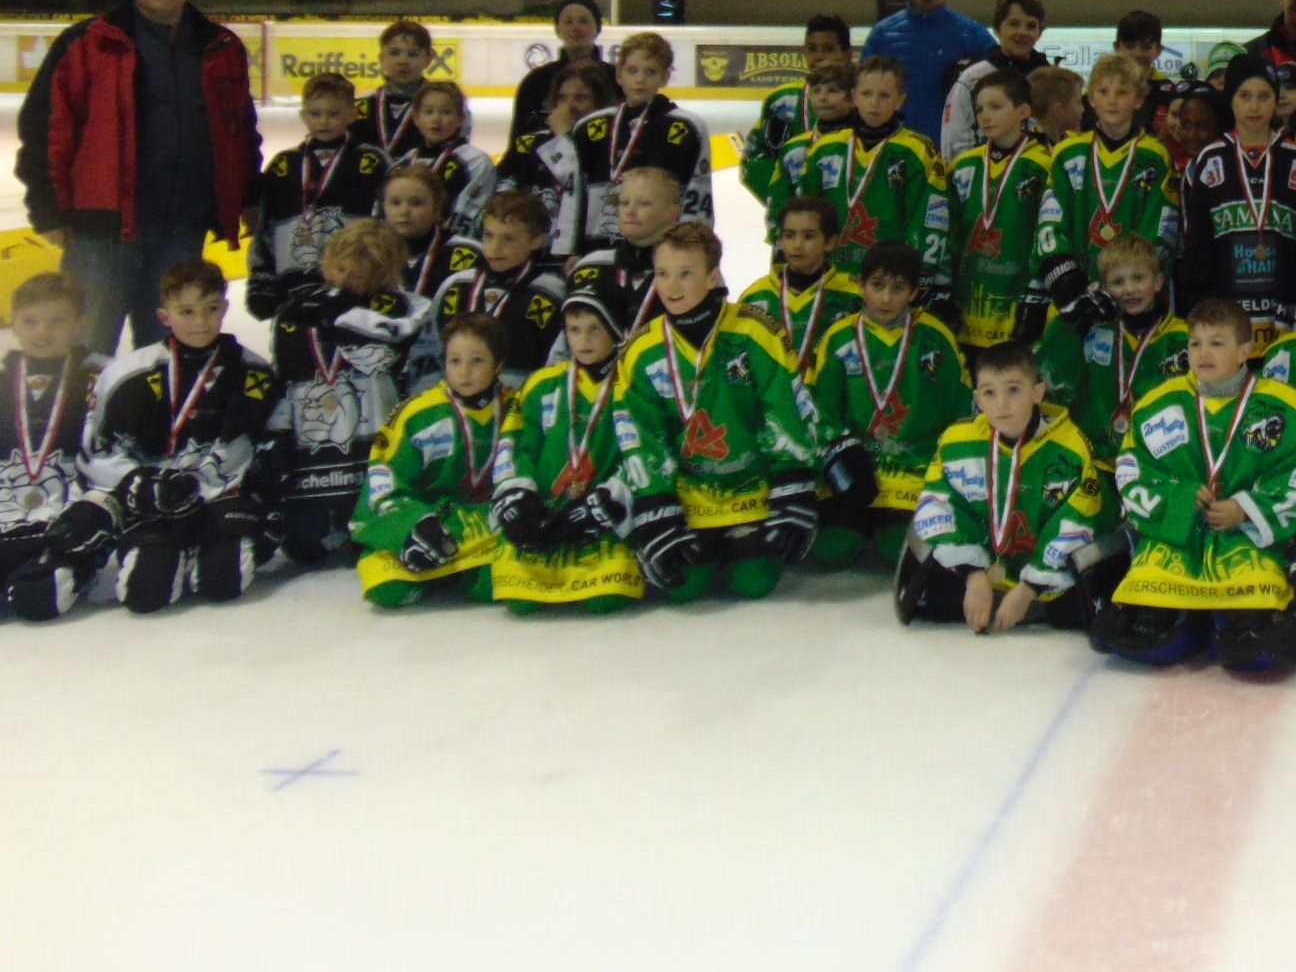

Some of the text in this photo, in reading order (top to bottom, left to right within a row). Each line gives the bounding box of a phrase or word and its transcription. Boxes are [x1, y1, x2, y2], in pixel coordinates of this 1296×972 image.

[281, 50, 386, 79] Raiffeis
[745, 52, 806, 69] ABSOL
[1213, 202, 1294, 228] SAMNA
[923, 234, 948, 264] 21
[297, 472, 364, 491] chelling
[730, 499, 758, 514] CAR
[571, 578, 598, 592] CAR
[600, 571, 641, 588] WORLD
[1226, 584, 1255, 597] CAR
